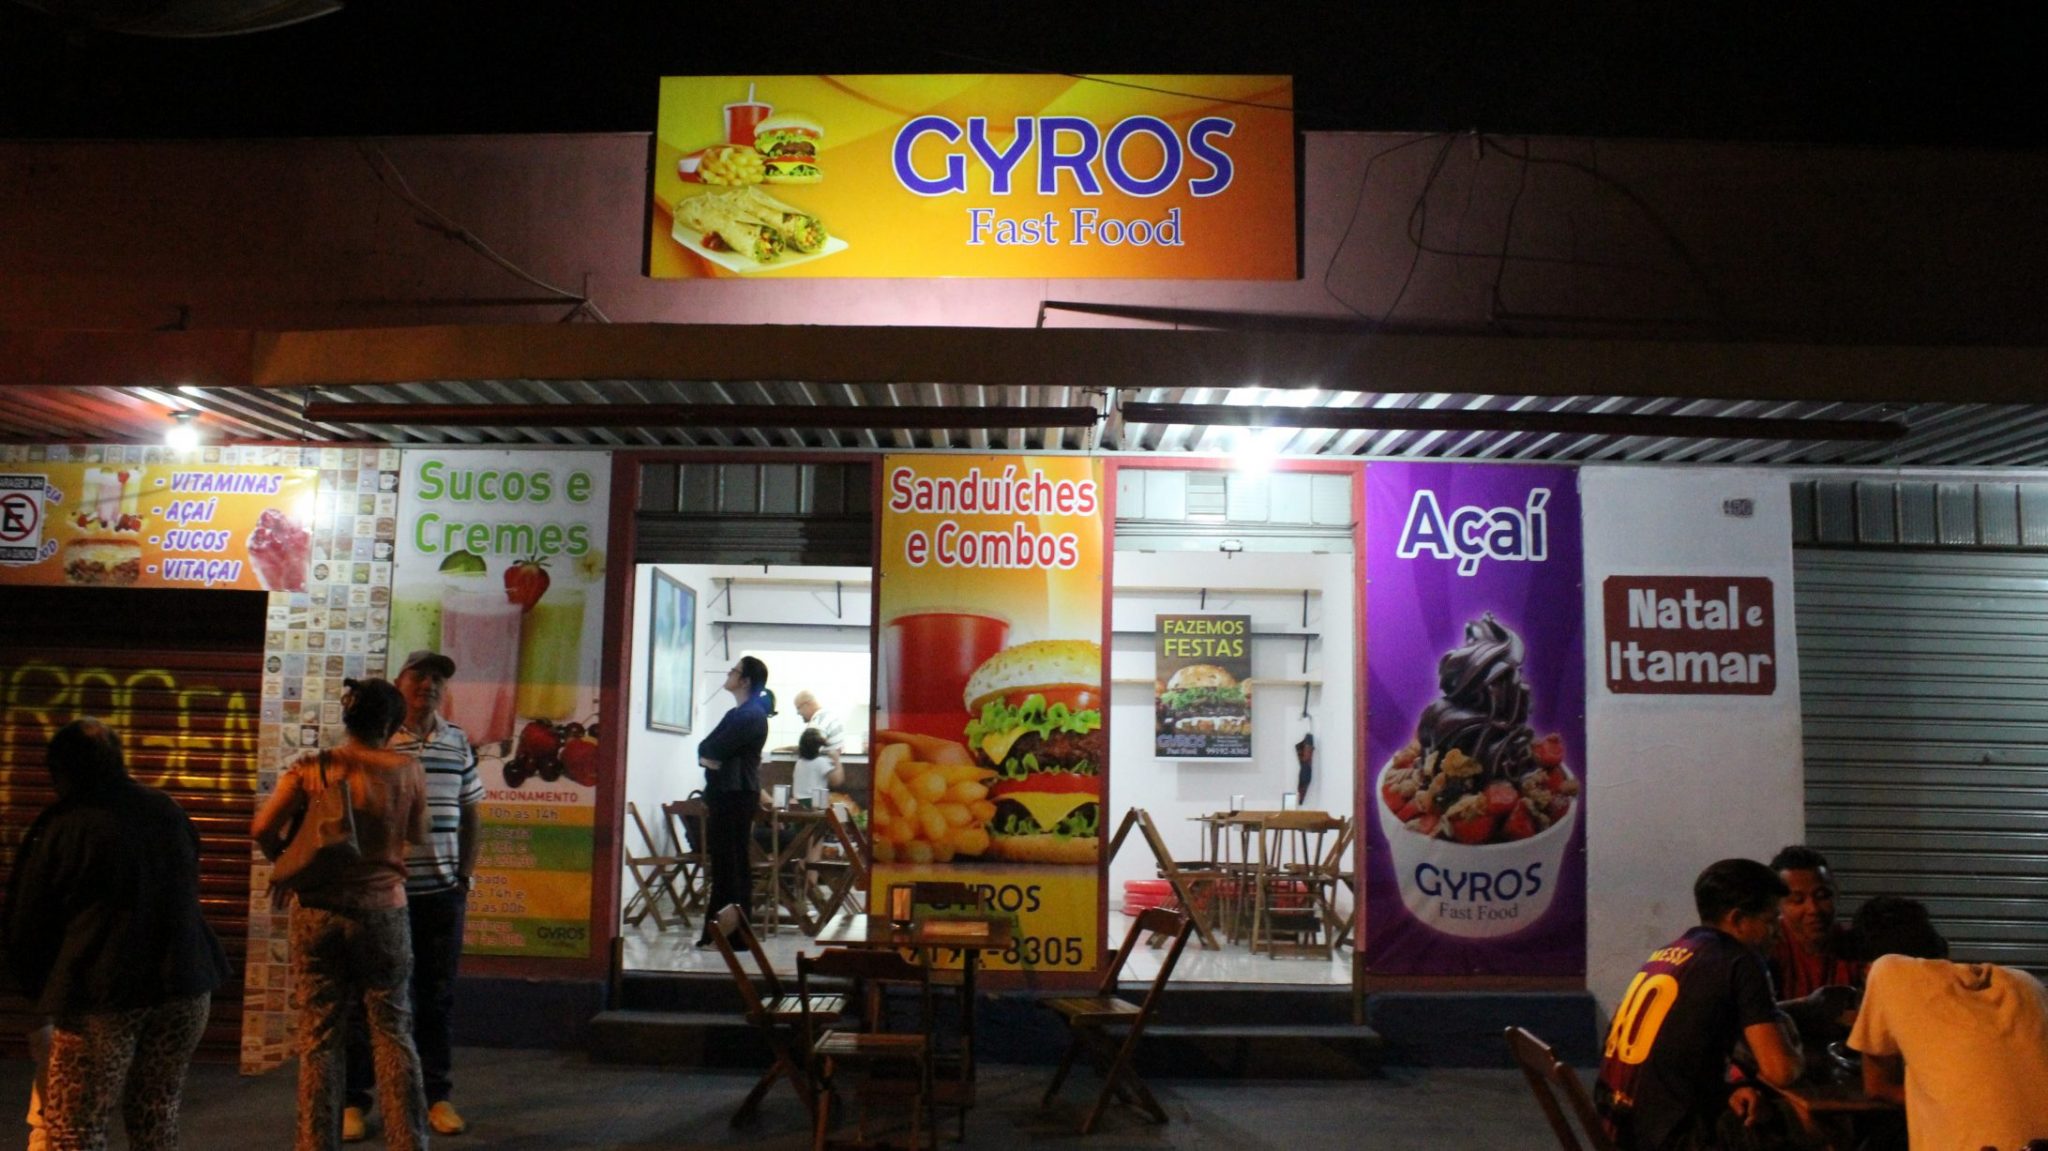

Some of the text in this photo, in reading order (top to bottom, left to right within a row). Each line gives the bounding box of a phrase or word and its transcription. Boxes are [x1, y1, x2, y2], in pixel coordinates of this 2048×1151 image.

[892, 115, 1234, 197] GYROS
[966, 208, 1184, 246] Fast Food
[169, 473, 282, 494] VITAMINAS
[418, 460, 592, 502] Sucos e
[890, 465, 1097, 516] Sanduíches
[165, 499, 216, 524] AÇAÍ
[162, 530, 229, 551] SUCOS
[415, 512, 589, 555] Cremes
[906, 520, 1079, 569] e Combos
[1397, 488, 1551, 576] Açaí
[162, 560, 242, 584] VITAÇAI
[1628, 586, 1763, 630] Natal e
[1164, 620, 1244, 635] FAZEMOS
[1164, 638, 1244, 657] FESTAS
[1610, 640, 1771, 684] Itamar
[484, 790, 578, 803] NCIONAMENTO
[1415, 862, 1542, 901] GYROS
[1439, 903, 1519, 920] Fast Food
[537, 926, 585, 941] GYROS
[1648, 947, 1694, 965] MESSI
[1605, 971, 1679, 1065] 10
